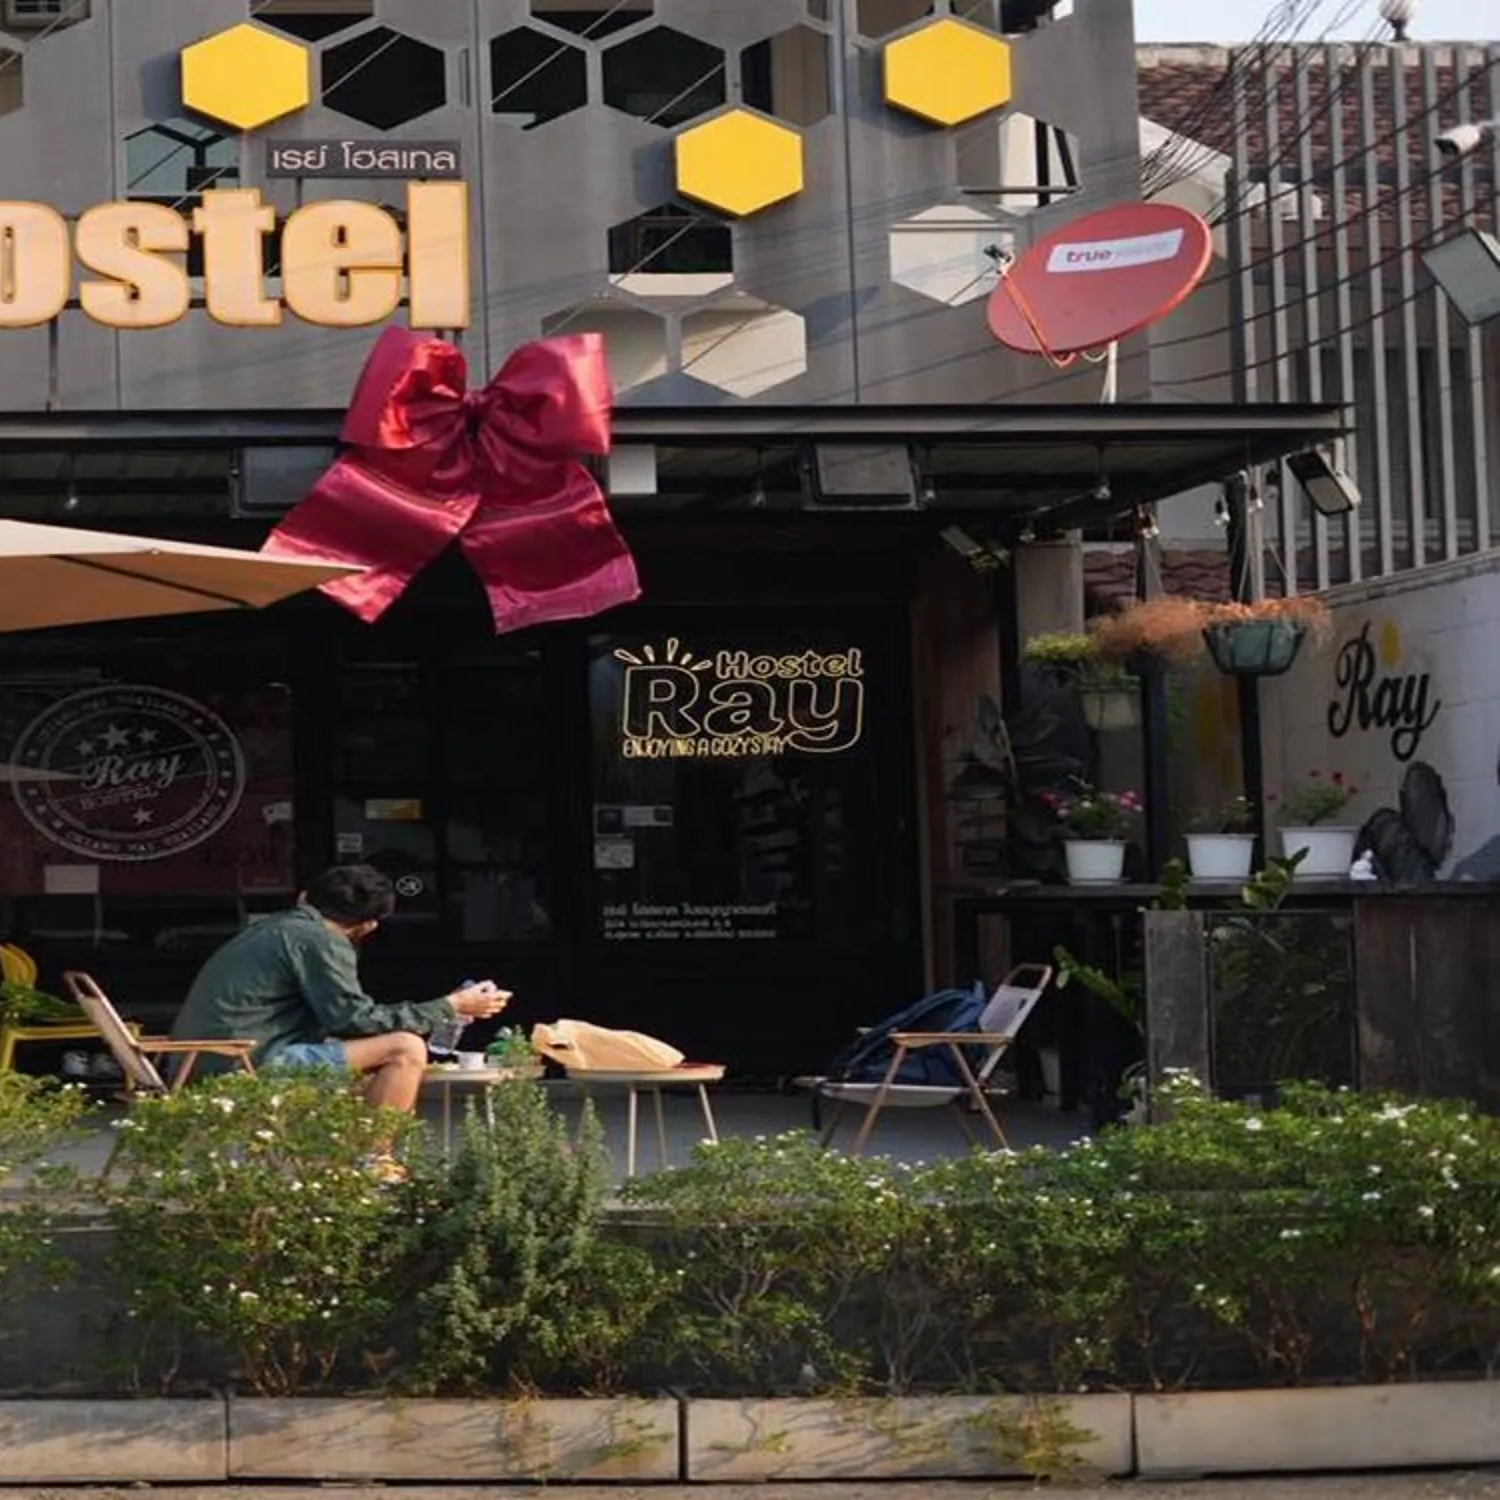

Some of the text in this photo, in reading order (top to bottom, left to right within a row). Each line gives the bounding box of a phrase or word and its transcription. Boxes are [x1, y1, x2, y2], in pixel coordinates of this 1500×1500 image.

[273, 141, 456, 170] เรย์ โฮสเทล
[716, 648, 864, 678] Hostel
[623, 664, 864, 752] Ray
[1328, 619, 1441, 762] Ray
[80, 753, 183, 790] Ray
